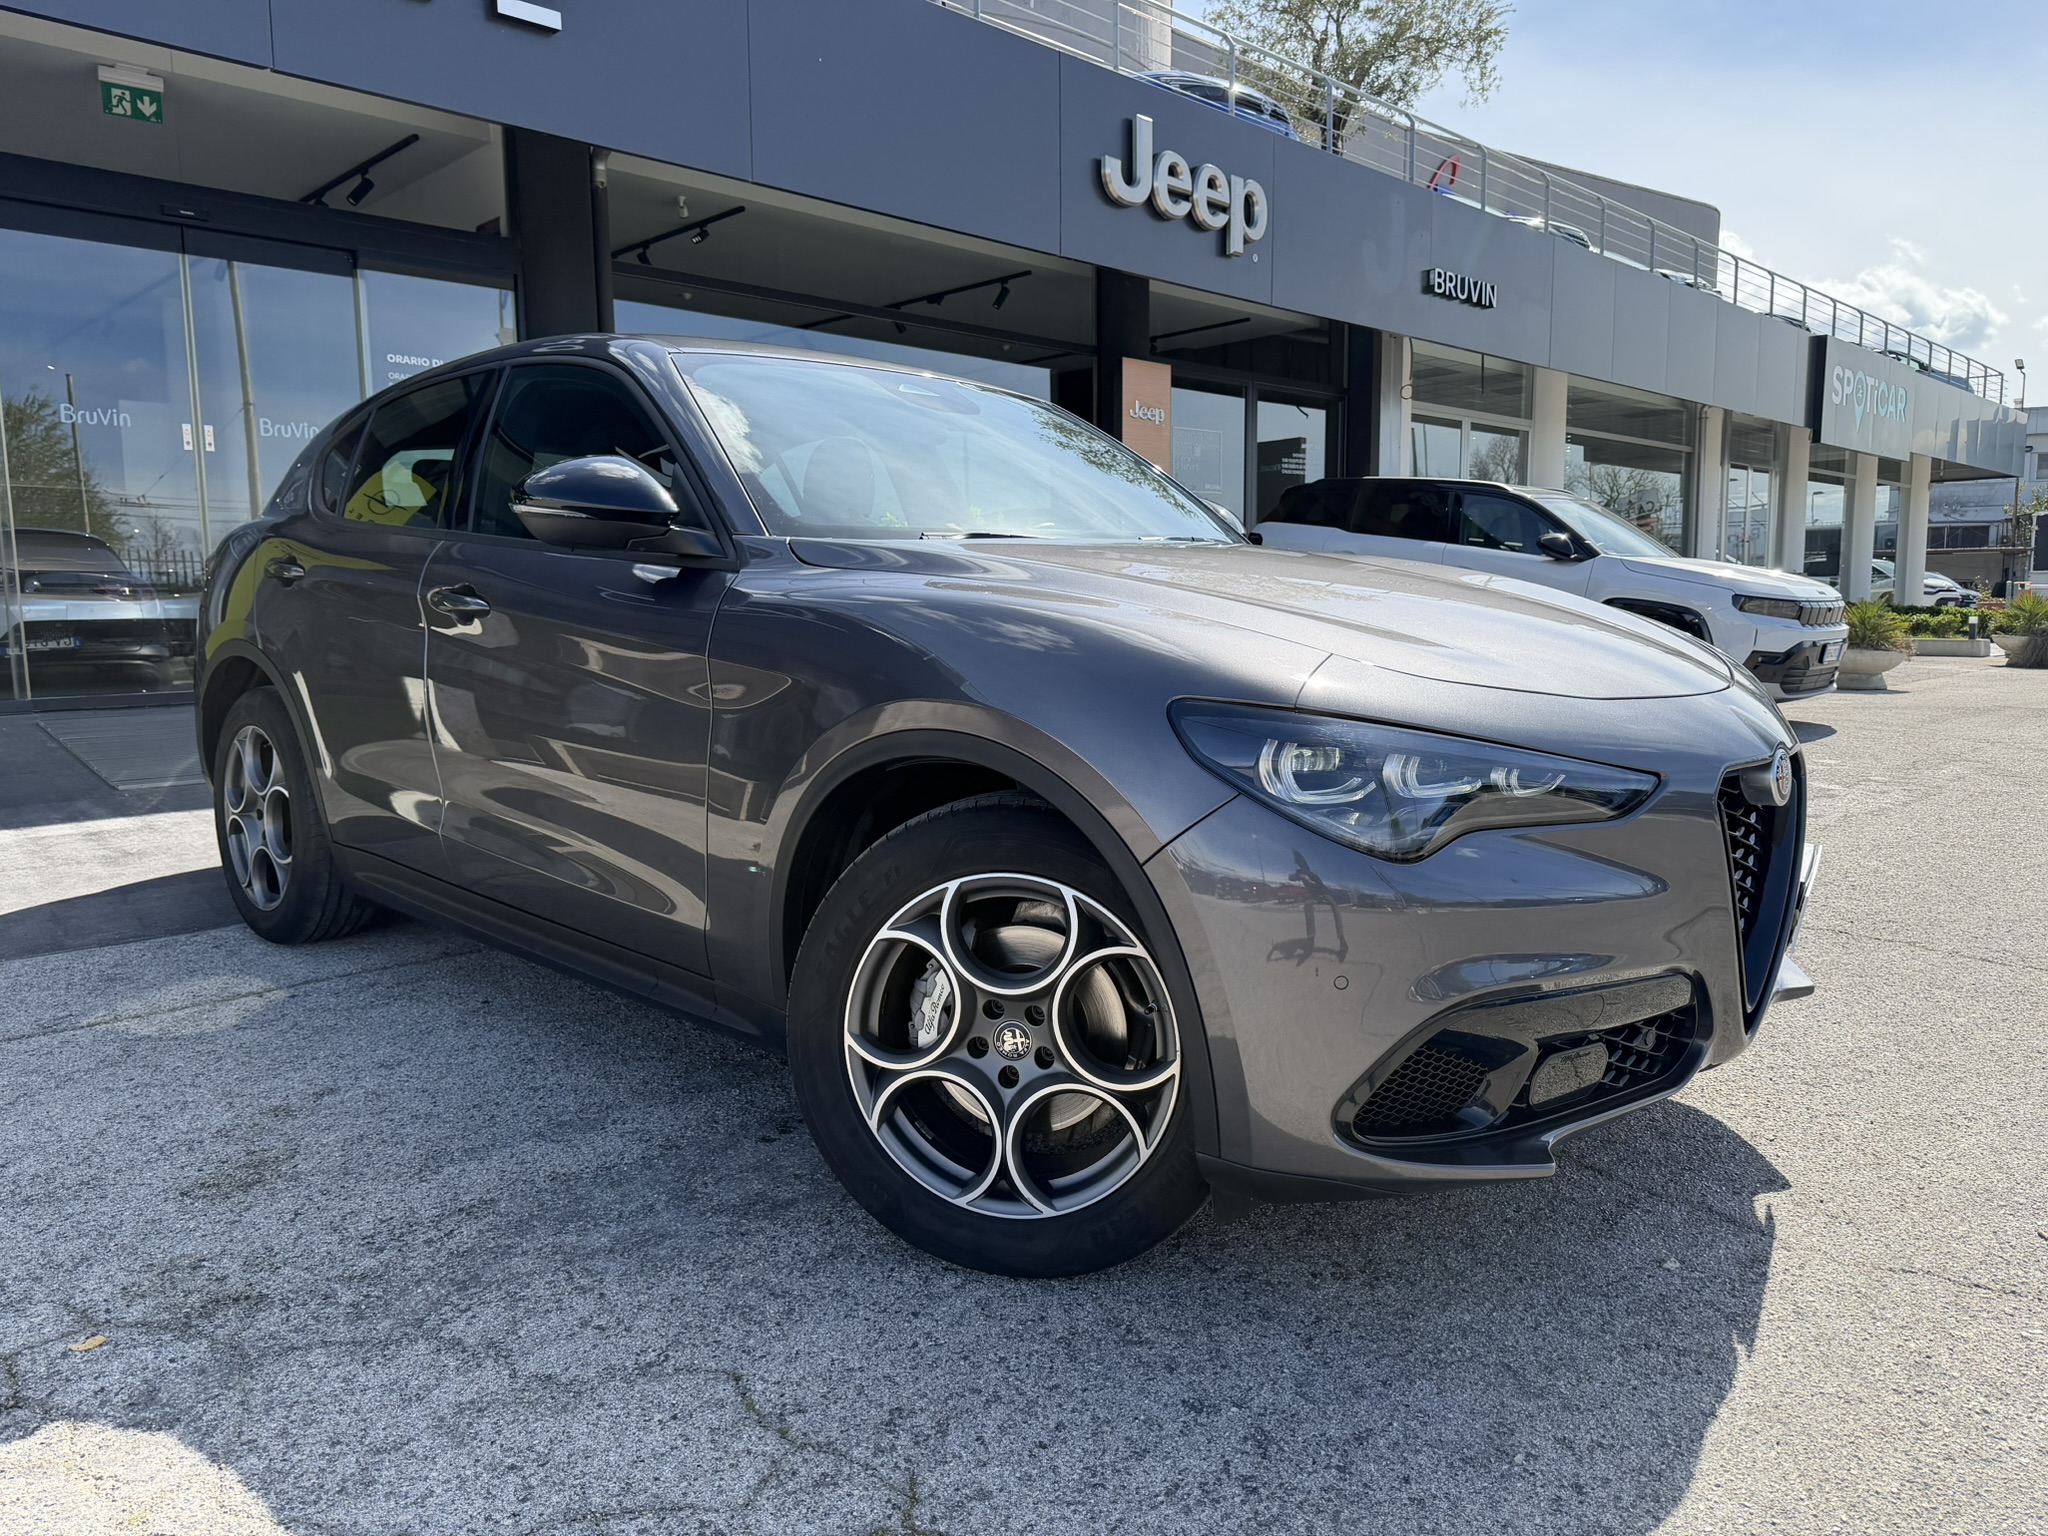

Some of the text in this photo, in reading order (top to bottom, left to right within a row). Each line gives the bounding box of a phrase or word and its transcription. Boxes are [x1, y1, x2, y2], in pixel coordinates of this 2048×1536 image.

[1101, 113, 1268, 257] Jeep
[1434, 267, 1497, 308] BRUVIN
[386, 353, 430, 367] ORARIO
[60, 403, 131, 427] BruVin
[1129, 399, 1164, 426] Jeep
[259, 417, 320, 439] BruVin
[925, 984, 945, 1034] Alfa Romeo
